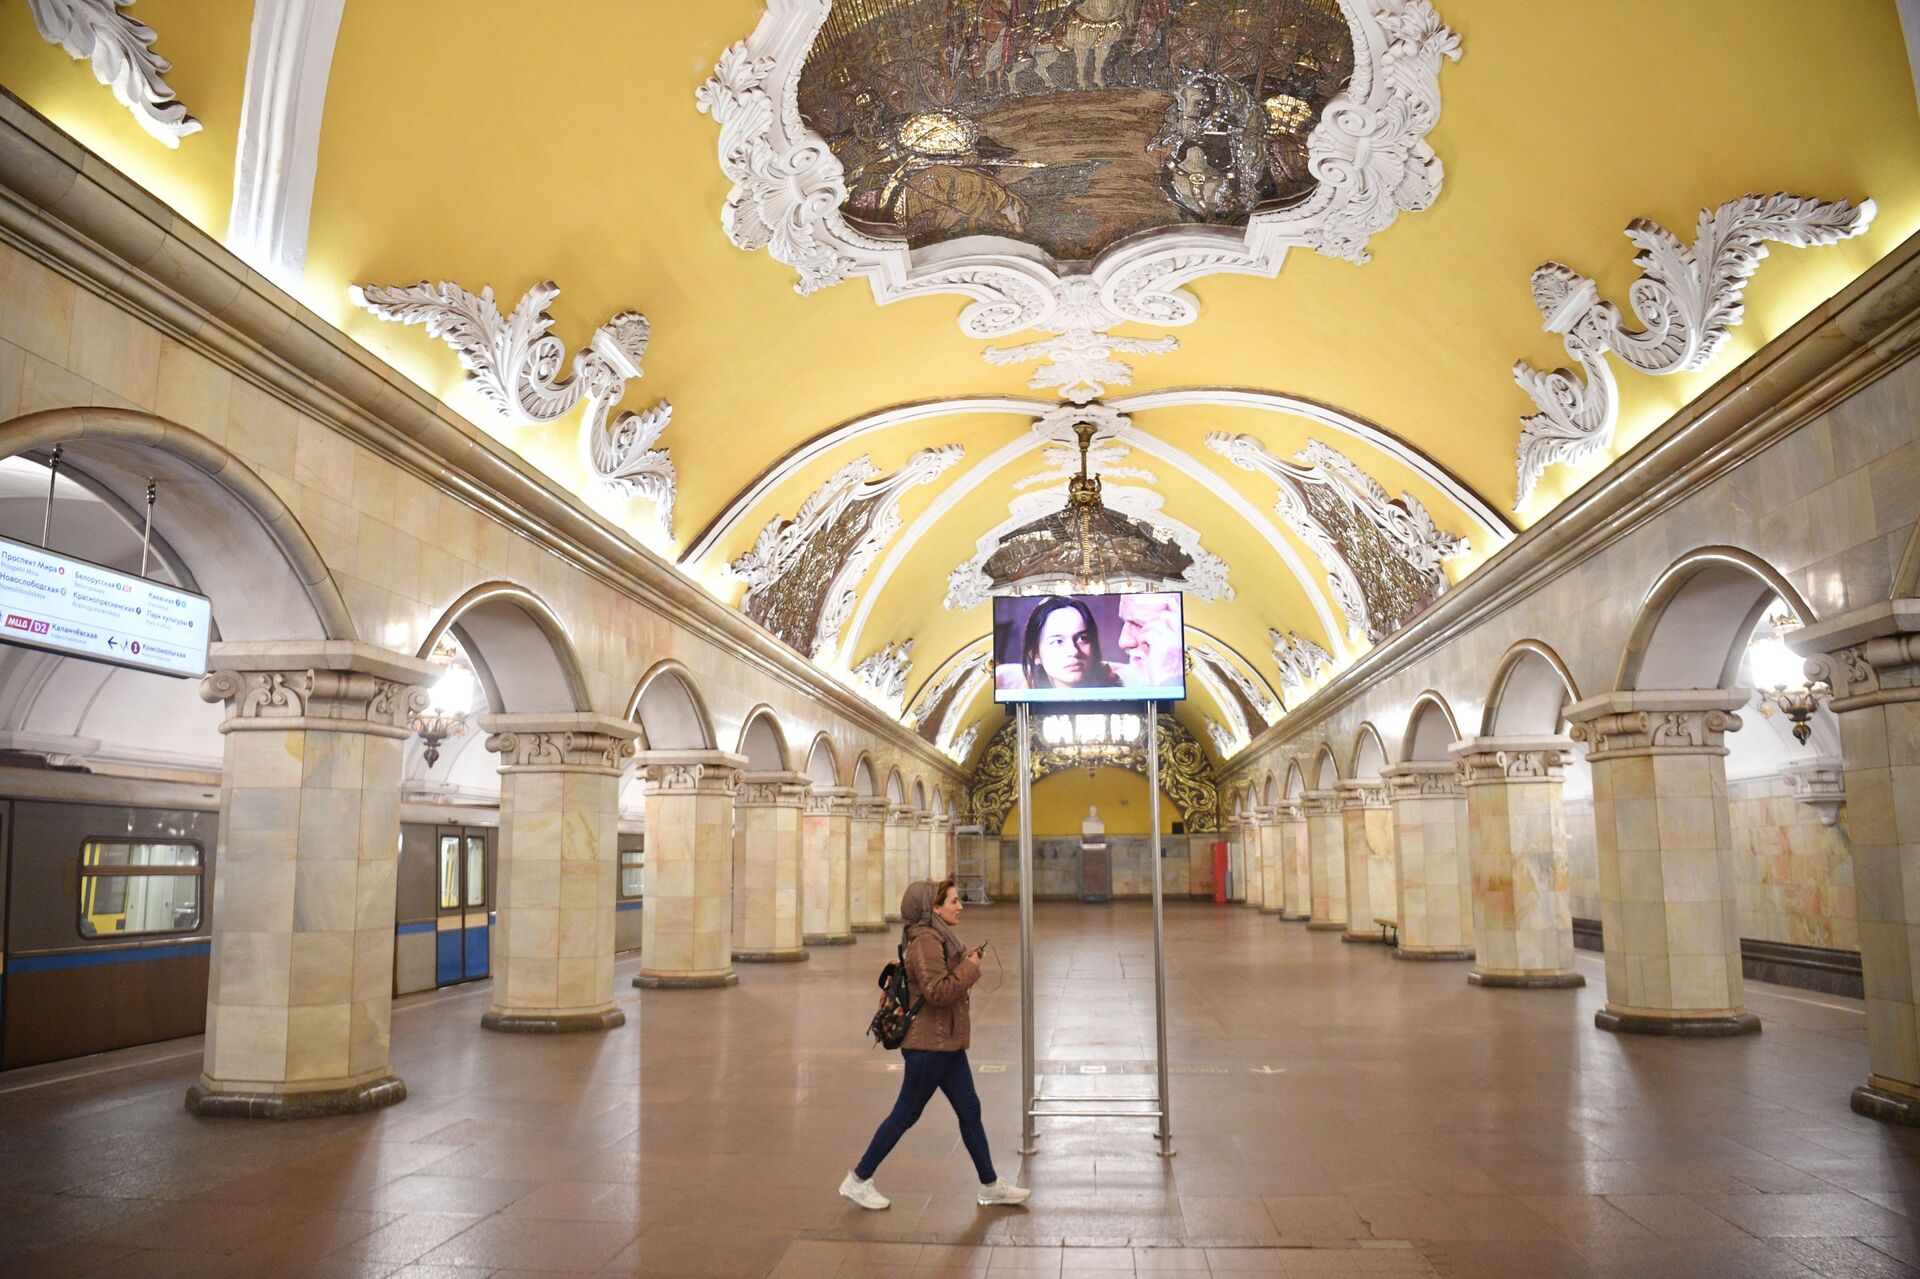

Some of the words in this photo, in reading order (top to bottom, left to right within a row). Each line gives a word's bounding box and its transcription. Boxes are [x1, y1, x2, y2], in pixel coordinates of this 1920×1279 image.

[1, 550, 36, 567] Проспект
[37, 561, 58, 573] Мира
[0, 572, 59, 593] Новослободская
[75, 571, 115, 588] Белорусская
[73, 591, 135, 613] Краснопресненская
[7, 616, 29, 629] МЦД
[34, 621, 47, 633] D2
